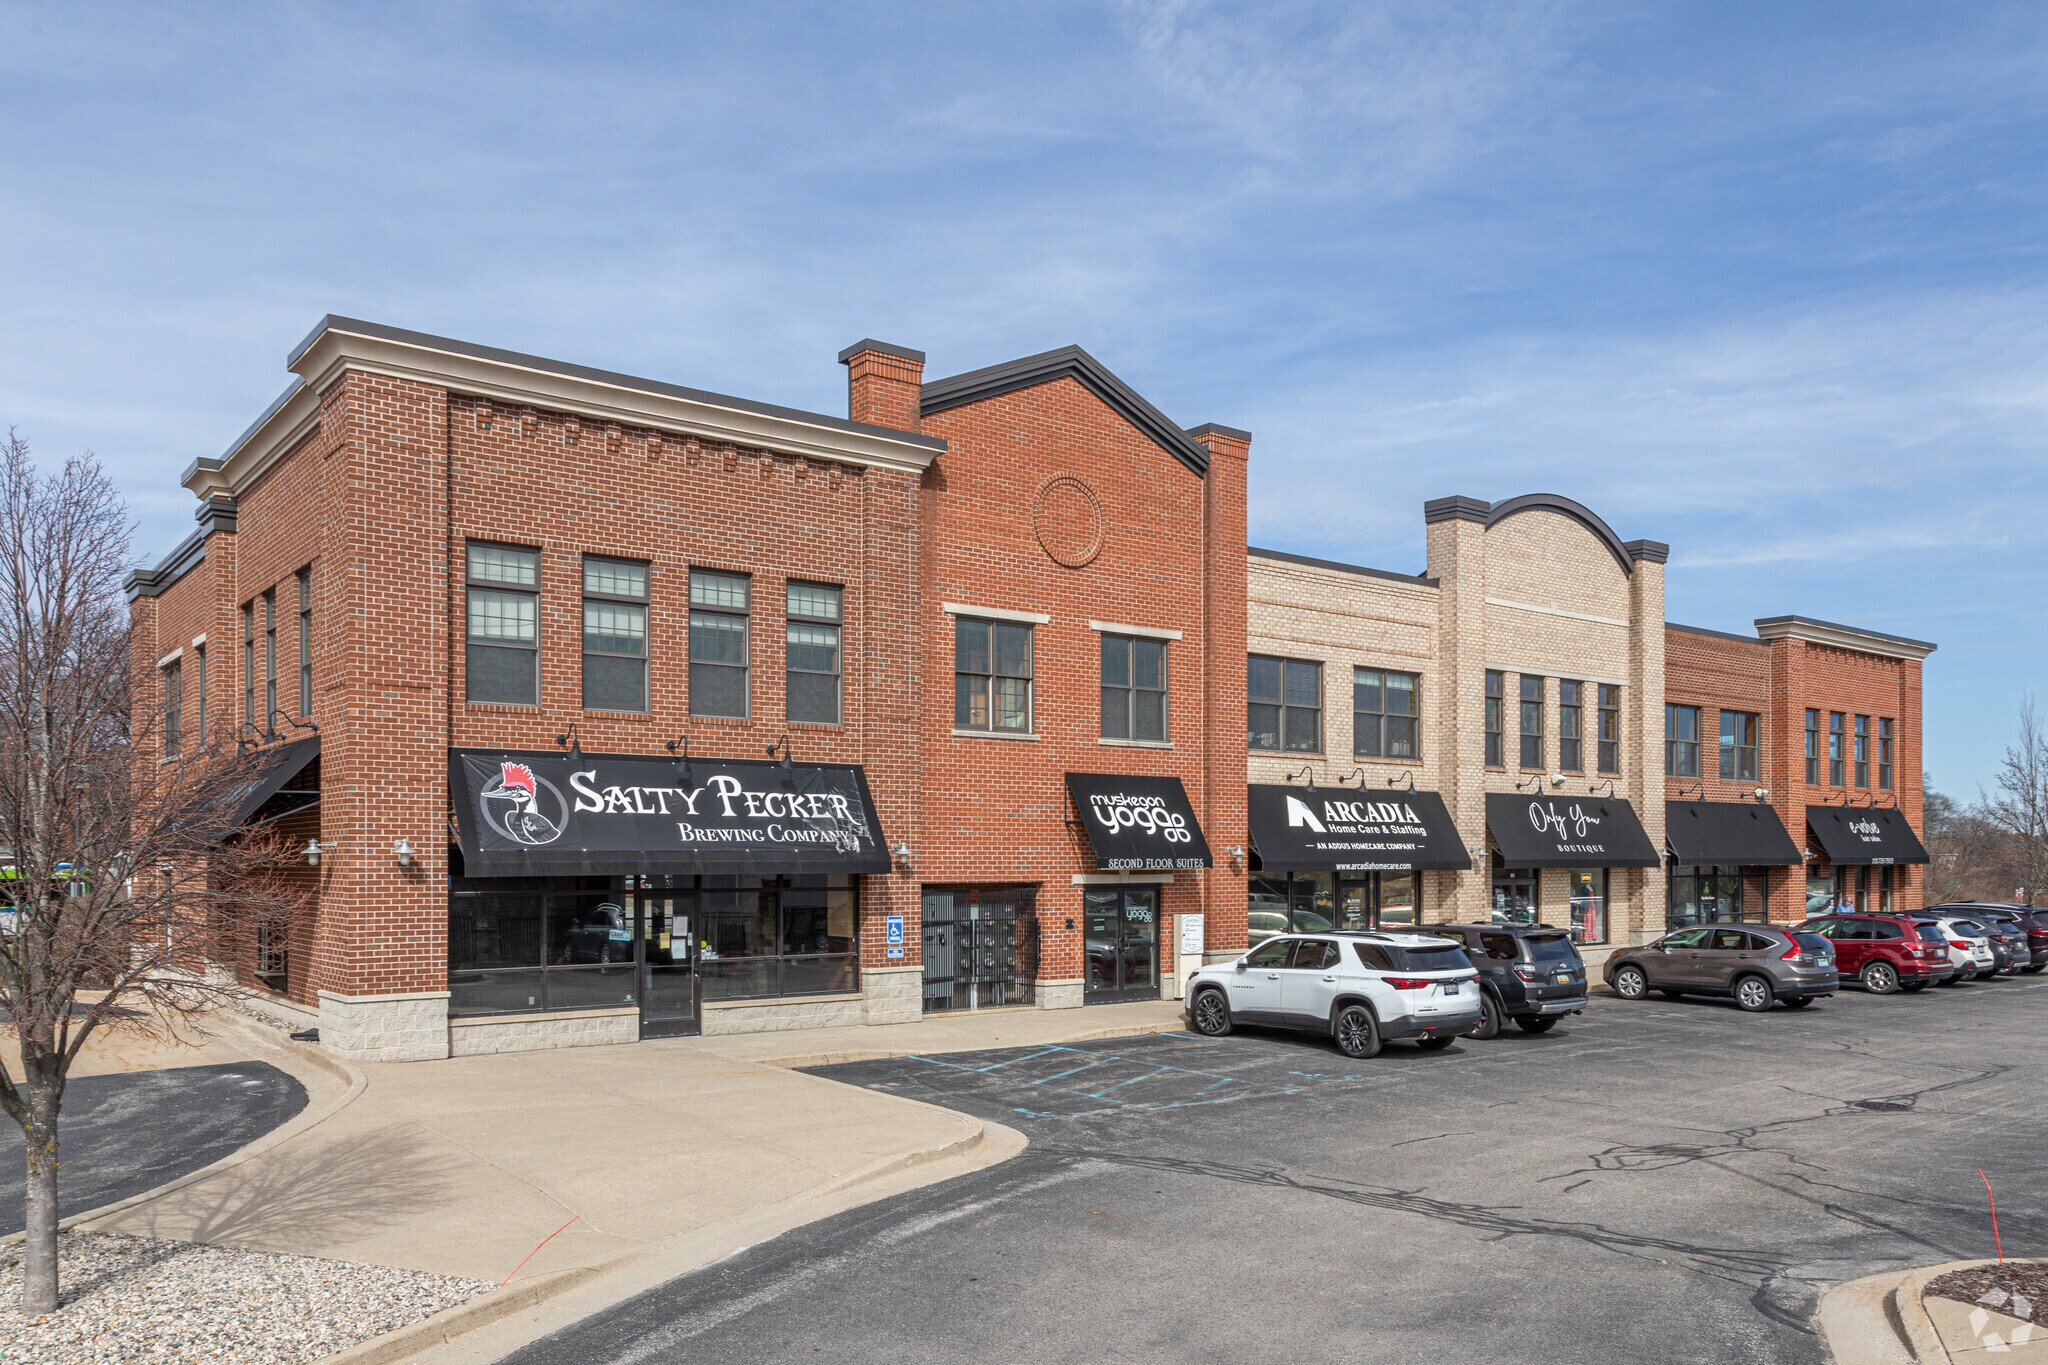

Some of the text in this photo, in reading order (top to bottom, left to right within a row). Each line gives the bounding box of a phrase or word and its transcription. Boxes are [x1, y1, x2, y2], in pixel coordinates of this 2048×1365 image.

[569, 770, 861, 826] SALTY PECKER
[1090, 793, 1165, 809] muskegon
[1324, 801, 1421, 823] ARCADIA
[1093, 805, 1175, 834] yoga
[1529, 802, 1600, 840] Only You
[677, 822, 765, 842] BREWING
[1328, 824, 1427, 837] Home Care & Staffing
[1328, 842, 1351, 850] ADDUS
[1352, 842, 1386, 850] HOMECARE
[1387, 842, 1416, 850] COMPANY
[1557, 844, 1605, 853] BOUTIQUE
[1108, 858, 1204, 868] SECOND FLOOR SUITES
[1336, 862, 1411, 870] www.arcadiahomecare.com
[1126, 910, 1149, 921] yoga
